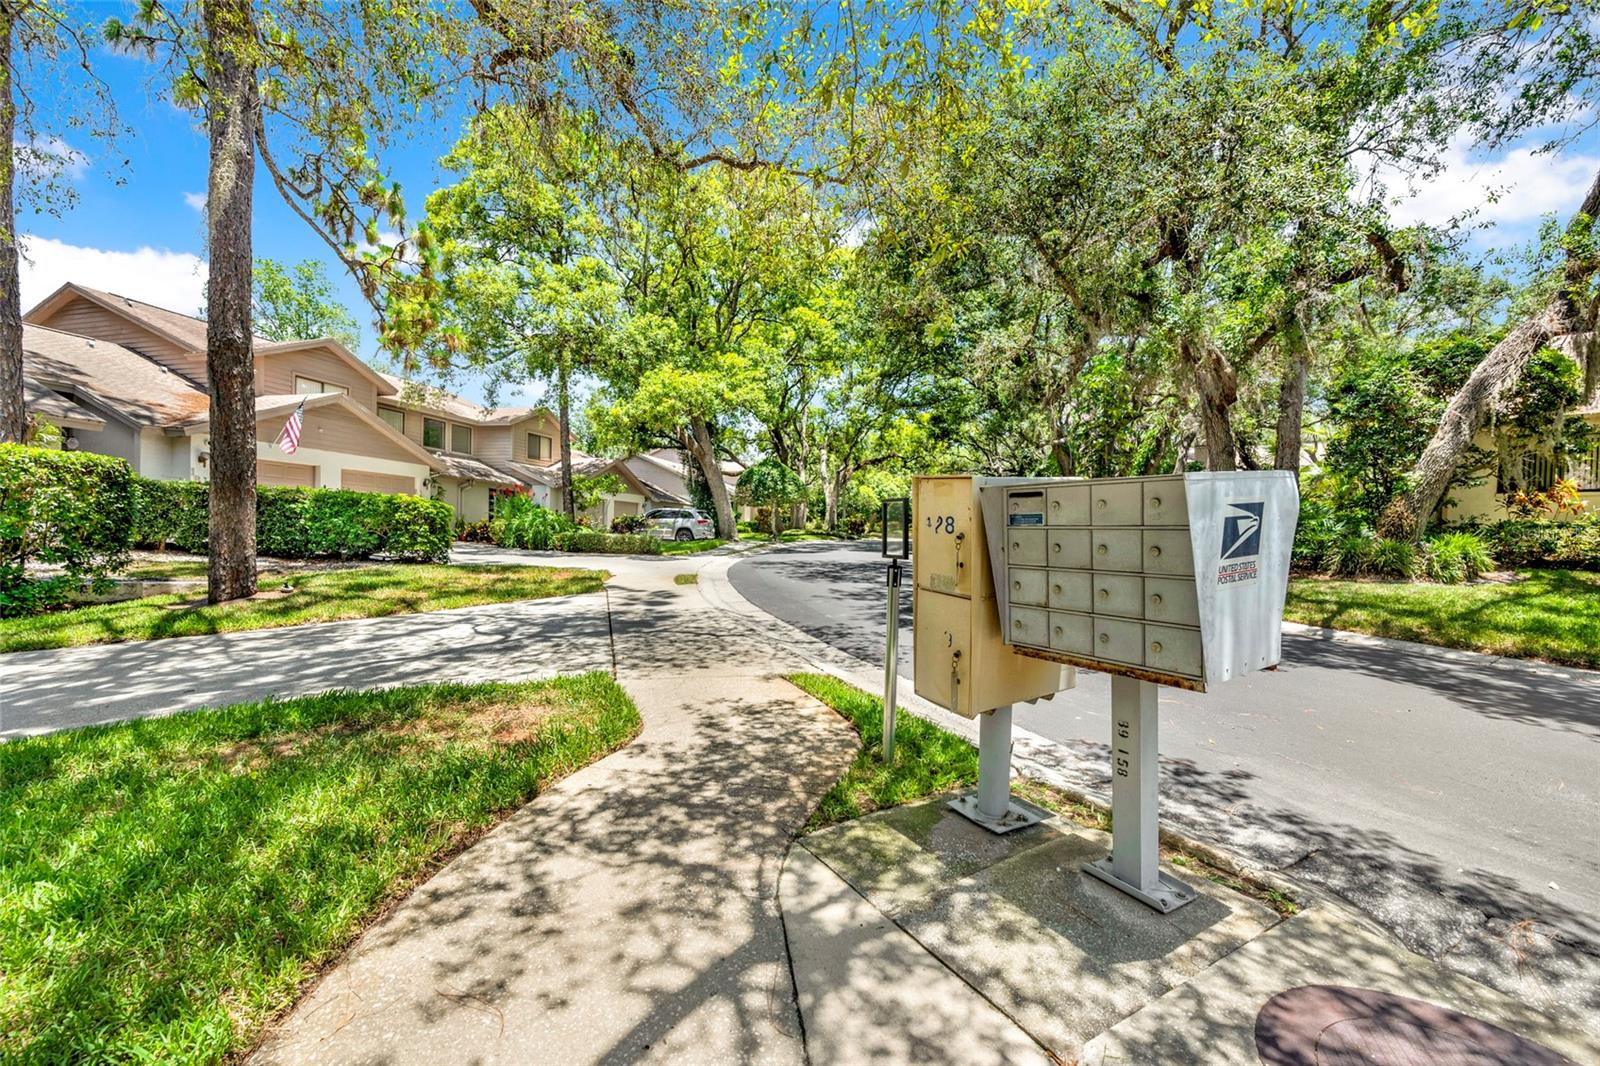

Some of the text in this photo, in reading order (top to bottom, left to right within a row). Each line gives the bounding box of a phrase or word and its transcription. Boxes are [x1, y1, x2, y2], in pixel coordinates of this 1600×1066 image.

[1218, 560, 1256, 574] UNITED STATES
[1217, 572, 1257, 585] POSTAL SERVICE
[1117, 749, 1129, 777] 158
